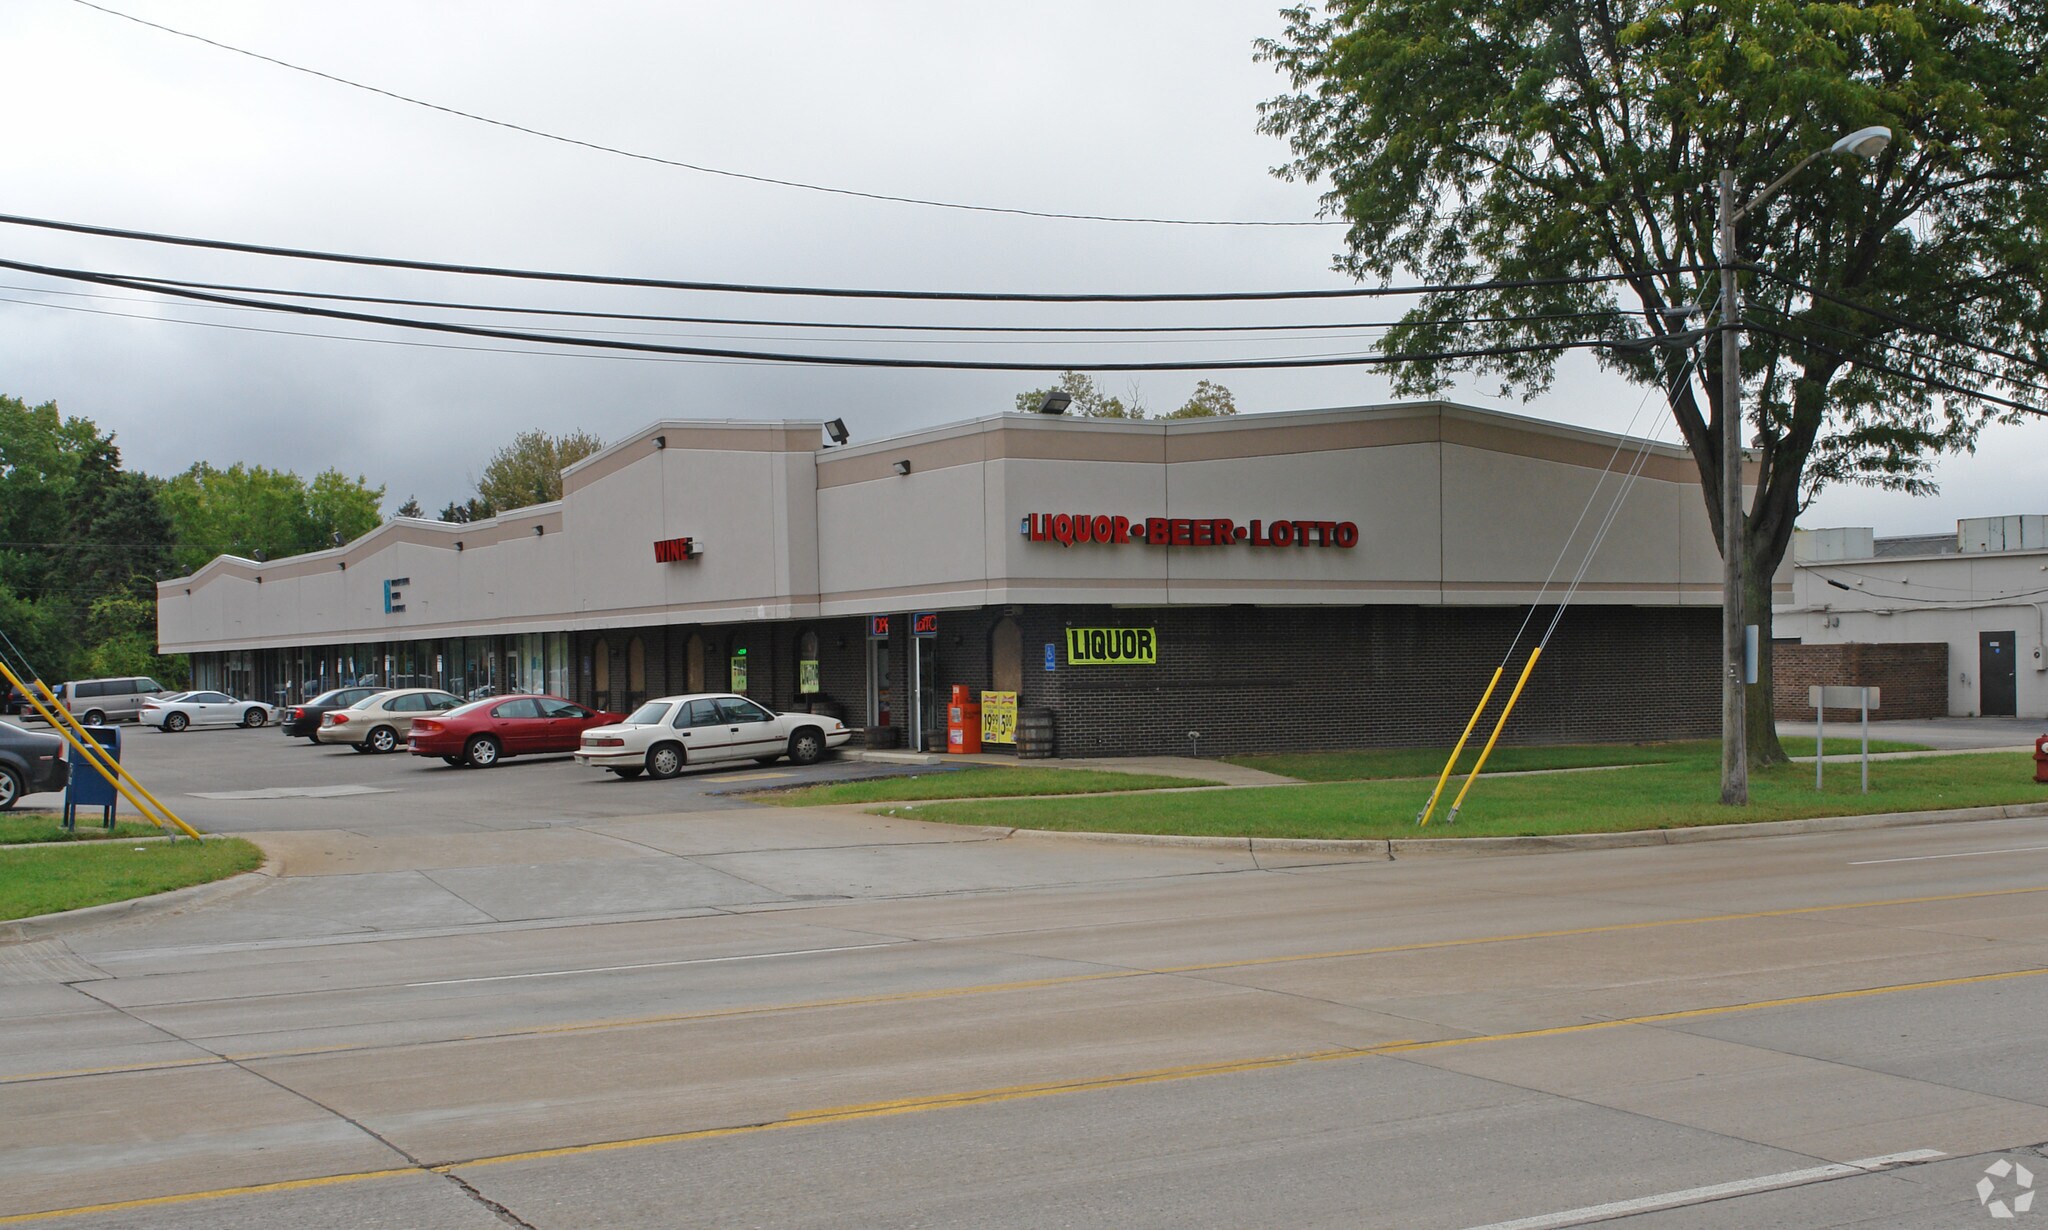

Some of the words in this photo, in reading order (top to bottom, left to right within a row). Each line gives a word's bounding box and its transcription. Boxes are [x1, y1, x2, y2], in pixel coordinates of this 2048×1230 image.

[1028, 513, 1130, 547] LIQUOR
[1146, 517, 1236, 545] BEER
[1250, 520, 1358, 547] LOTTO
[653, 537, 692, 562] WINE
[1071, 629, 1153, 660] LIQUOR
